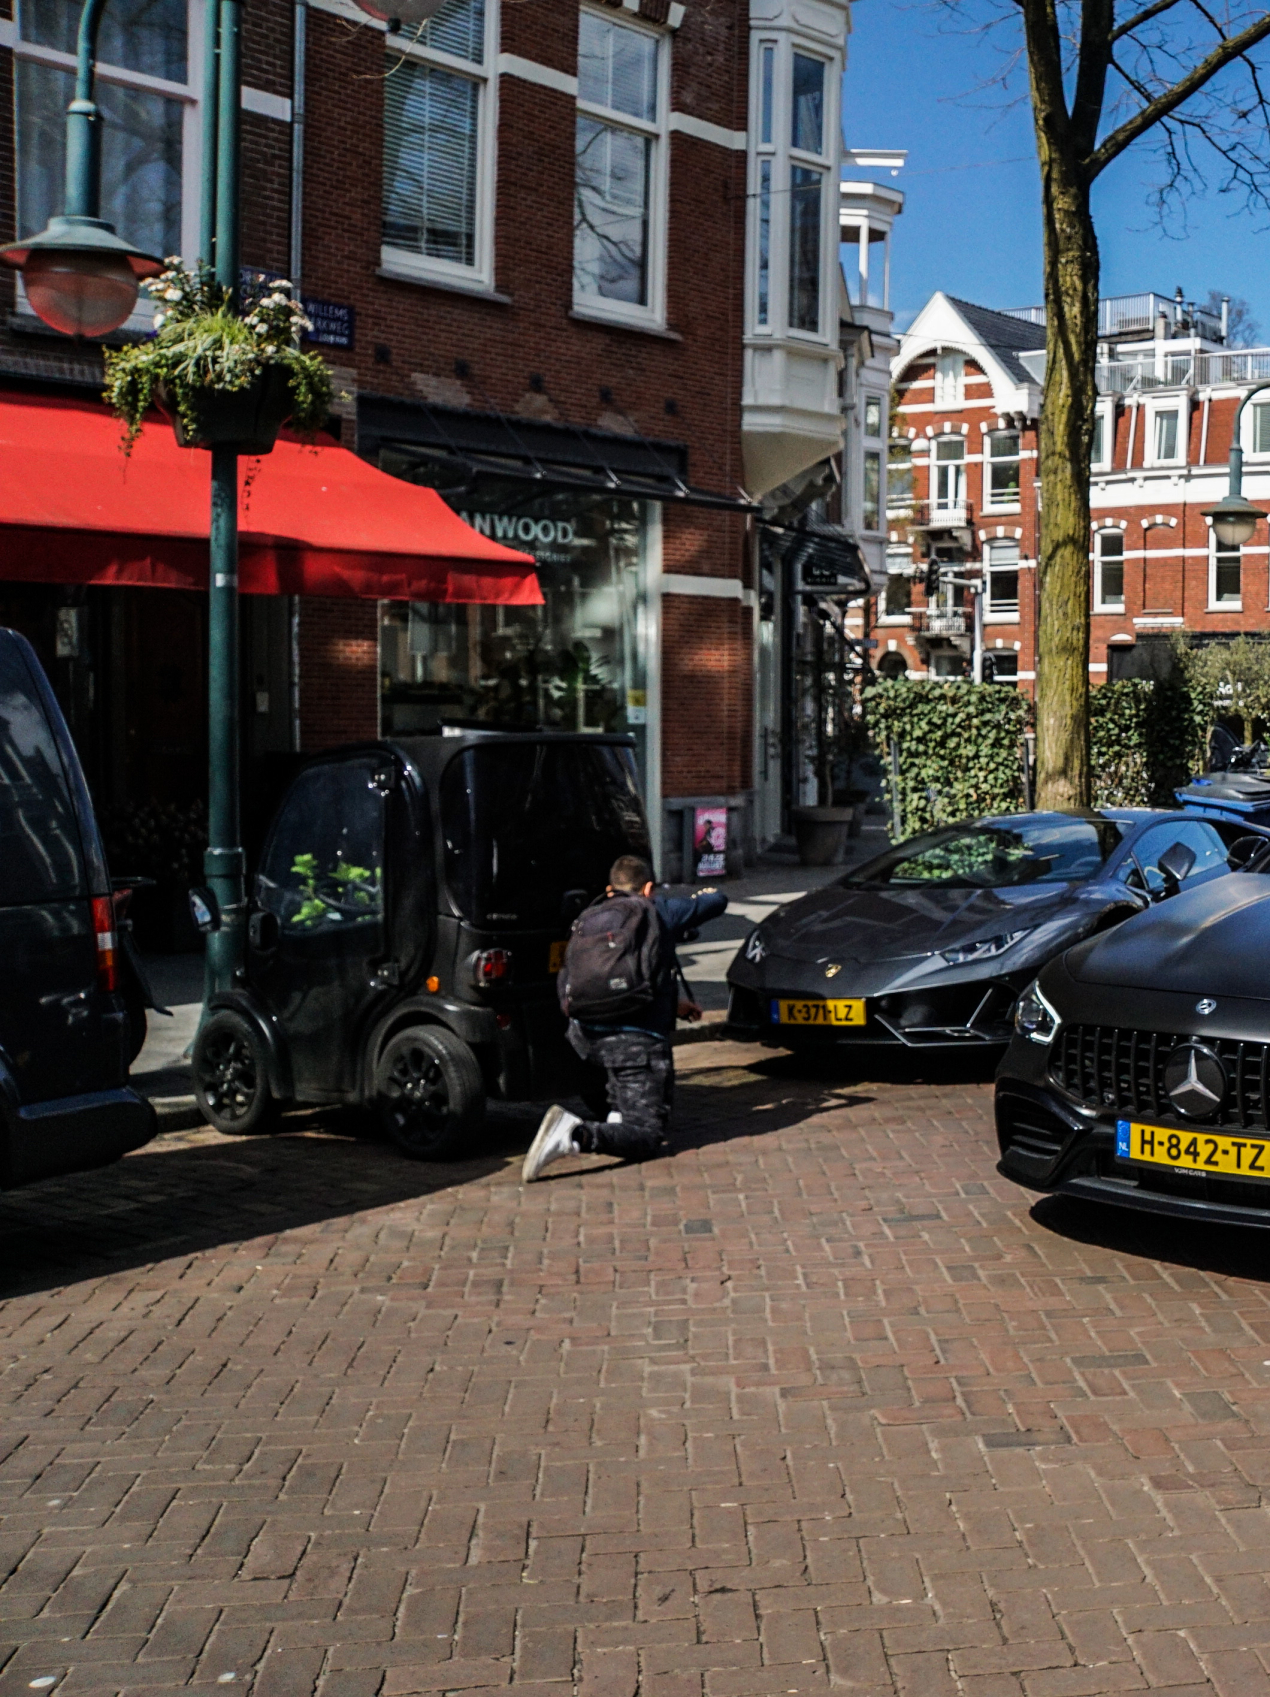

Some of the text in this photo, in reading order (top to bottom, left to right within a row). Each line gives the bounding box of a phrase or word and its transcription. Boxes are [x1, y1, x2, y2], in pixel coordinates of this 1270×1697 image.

[306, 301, 349, 321] WILLEMS
[786, 1003, 854, 1022] K-371-LZ
[1118, 1141, 1129, 1152] NL
[1140, 1128, 1266, 1172] H-842-TZ
